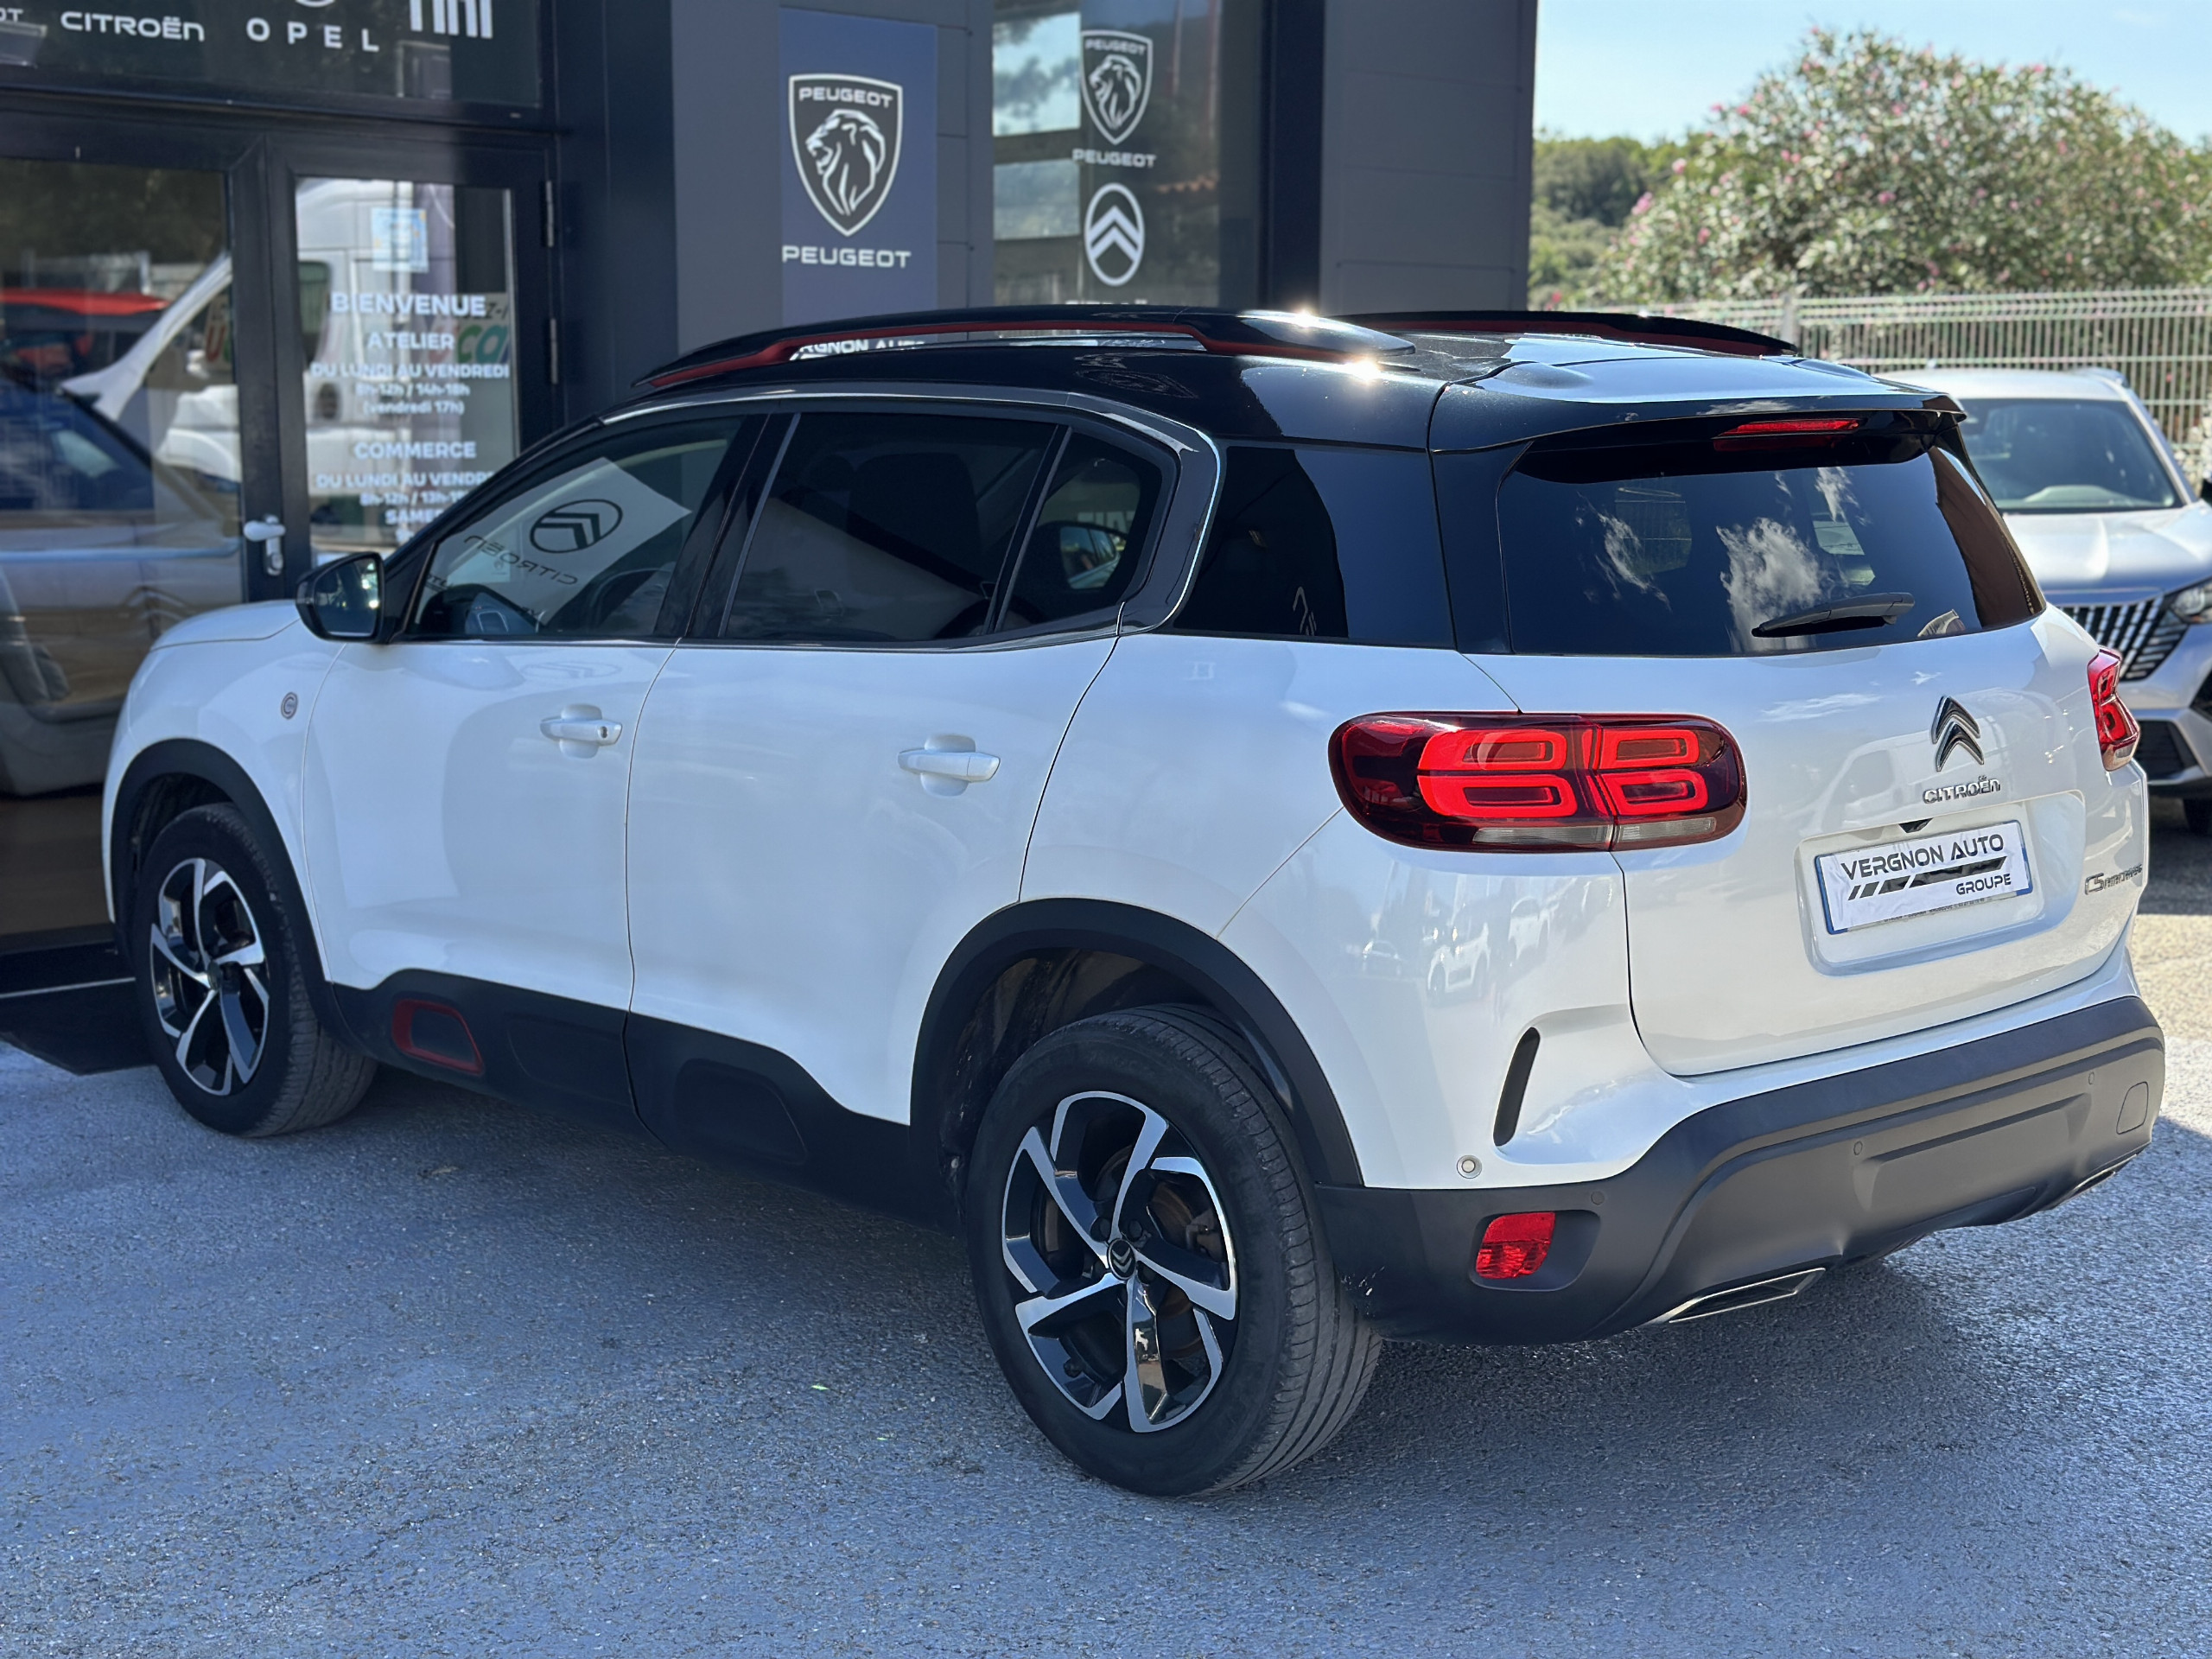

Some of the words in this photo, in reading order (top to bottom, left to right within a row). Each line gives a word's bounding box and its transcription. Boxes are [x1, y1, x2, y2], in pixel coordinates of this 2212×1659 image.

[245, 17, 380, 52] OPEL
[1084, 38, 1147, 55] PEUGEOT
[798, 86, 893, 108] PEUGEOT
[1072, 148, 1156, 168] PEUGEOT
[782, 245, 912, 269] PEUGEOT
[330, 292, 486, 316] BIENVENUE
[367, 331, 455, 350] ATELIER
[310, 362, 337, 378] DU
[340, 362, 393, 378] LUNDI
[397, 362, 422, 378] AU
[424, 363, 510, 378] VENDREDI
[353, 441, 477, 460] COMMERCE
[316, 473, 342, 488] DU
[346, 473, 397, 487] LUNDI
[401, 472, 427, 486] AU
[1840, 845, 1944, 880] VERGNON
[1950, 834, 2004, 861] AUTO
[1955, 873, 2012, 895] GROUPE
